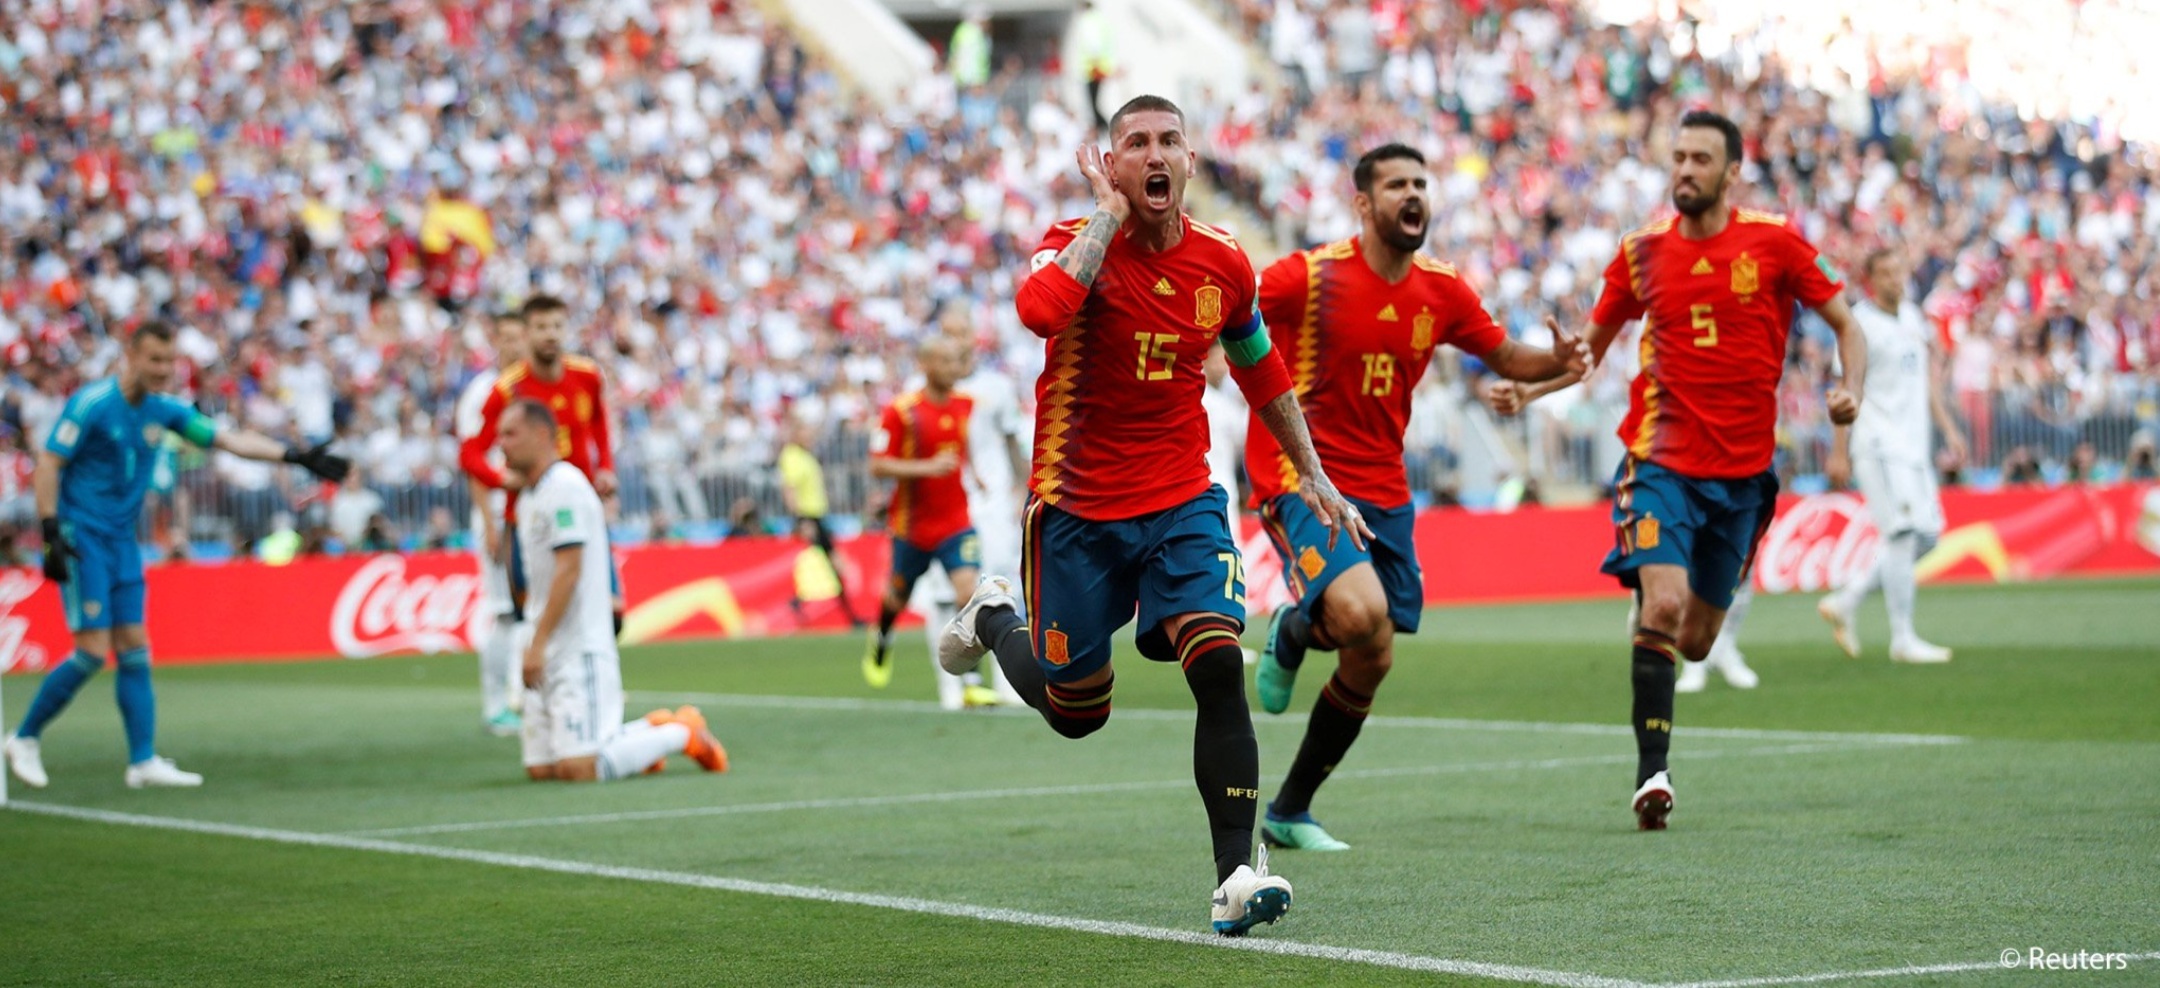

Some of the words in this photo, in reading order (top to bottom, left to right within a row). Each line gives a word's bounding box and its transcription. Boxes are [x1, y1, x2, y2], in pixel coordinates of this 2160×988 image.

[1690, 303, 1718, 348] 5
[1134, 331, 1180, 380] 15
[1361, 352, 1395, 397] 19
[329, 552, 485, 660] Coca
